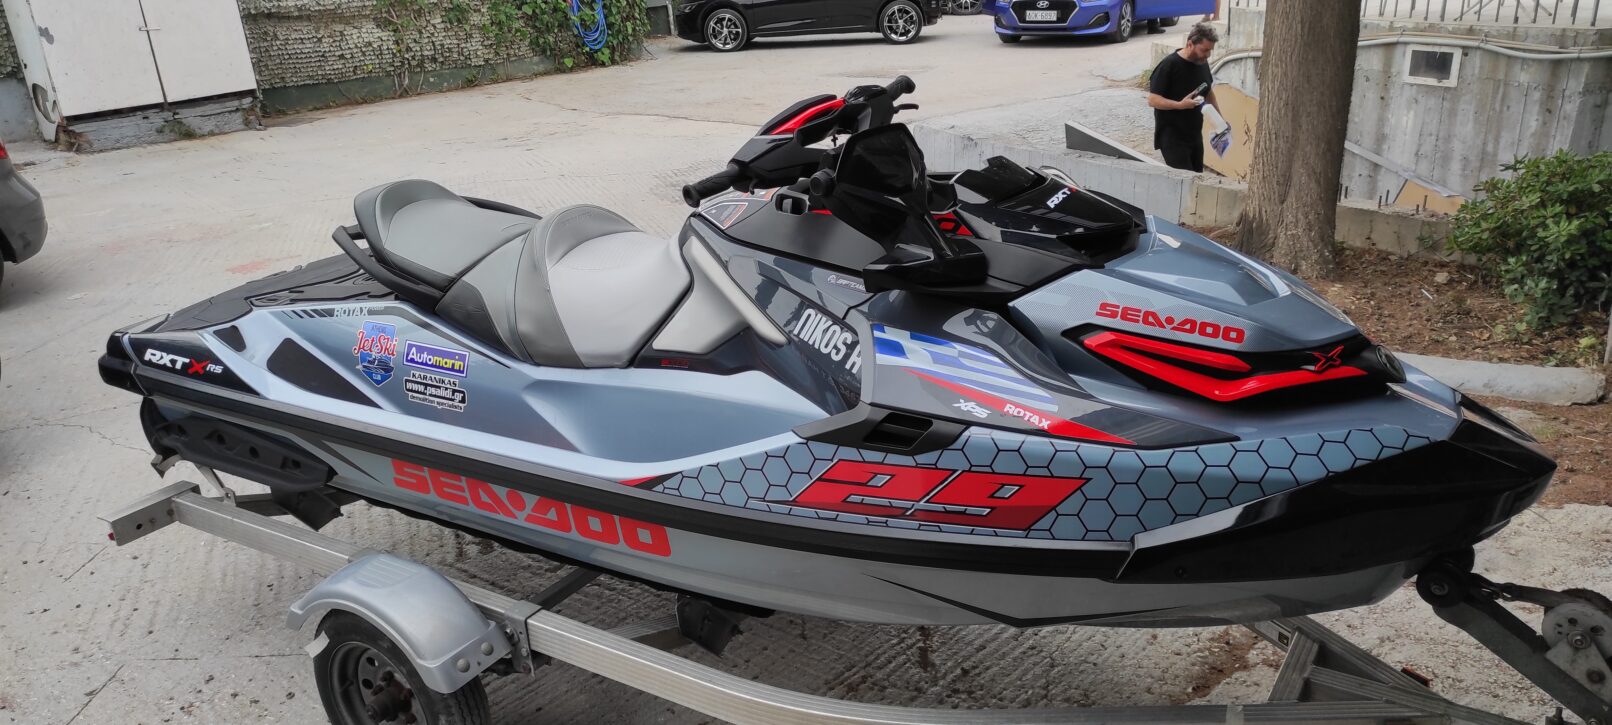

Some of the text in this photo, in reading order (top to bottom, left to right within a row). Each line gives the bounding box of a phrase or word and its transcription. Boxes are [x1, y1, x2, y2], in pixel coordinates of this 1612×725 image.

[1046, 187, 1072, 209] RXT
[334, 306, 369, 318] ROTAX
[793, 308, 853, 361] NIKOS
[407, 346, 465, 371] Automarin
[406, 380, 464, 403] www.psalidi.gr
[411, 372, 458, 388] KARANIKAS
[952, 398, 992, 418] XPS
[1003, 403, 1051, 429] ROTAX
[786, 458, 1092, 532] 29
